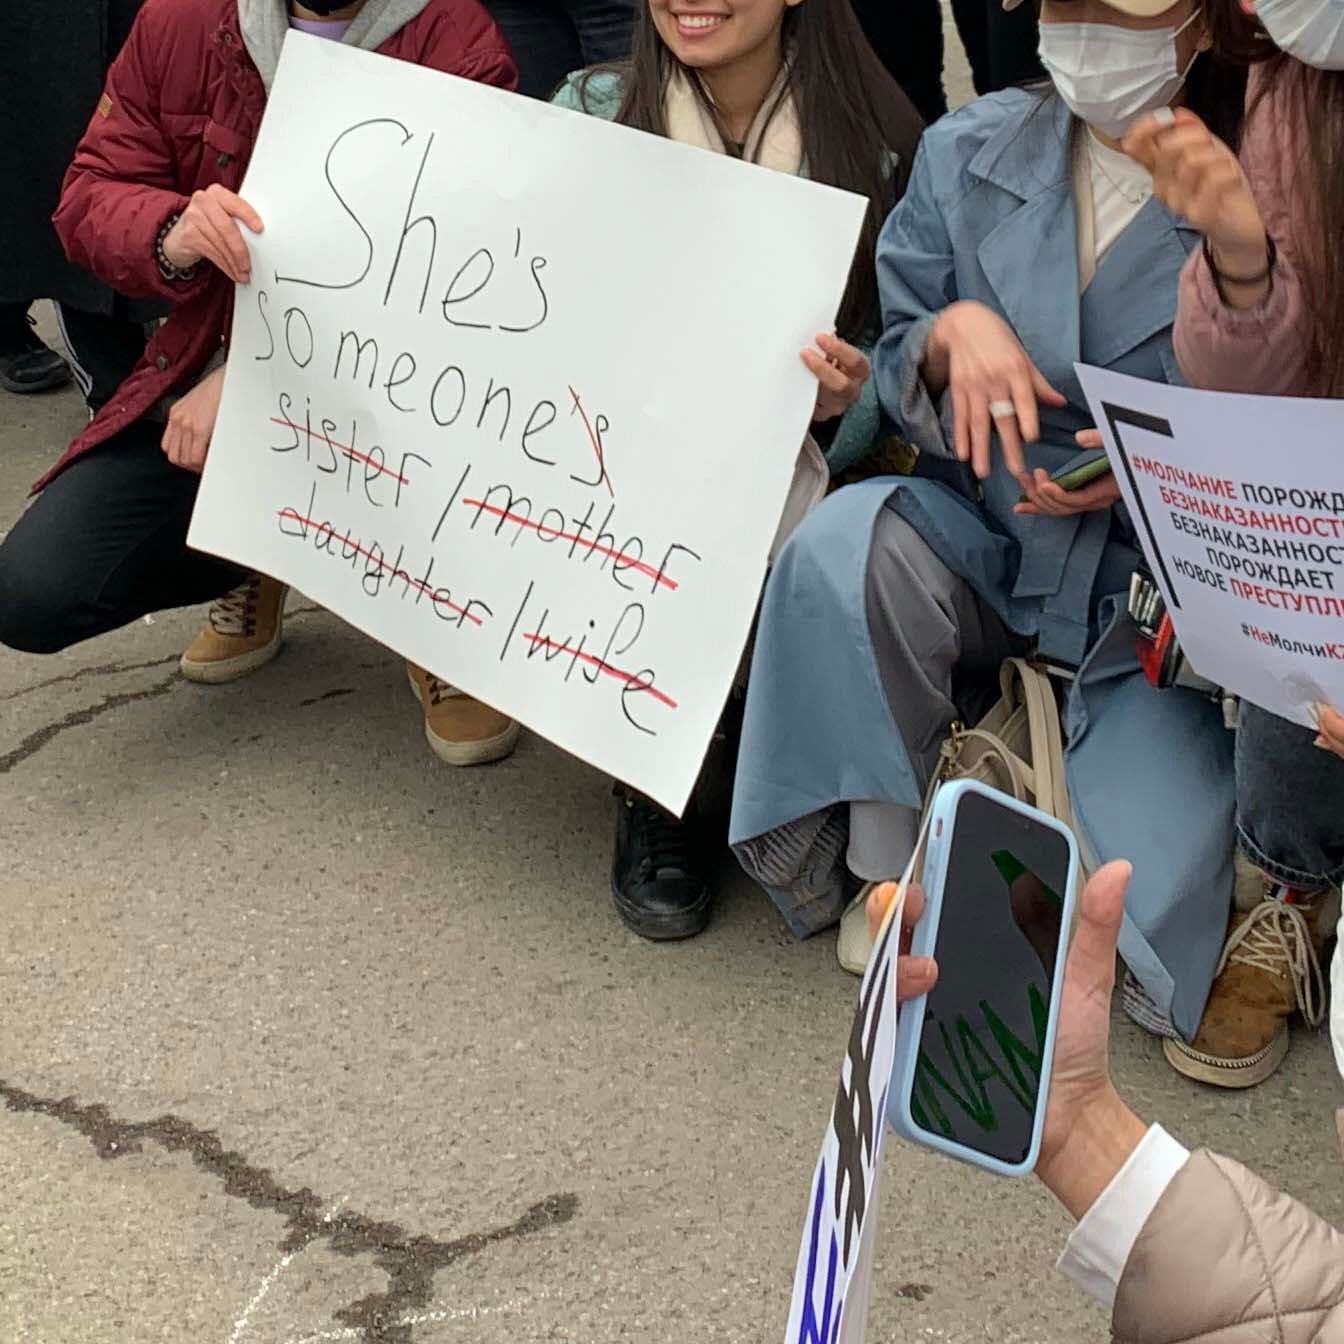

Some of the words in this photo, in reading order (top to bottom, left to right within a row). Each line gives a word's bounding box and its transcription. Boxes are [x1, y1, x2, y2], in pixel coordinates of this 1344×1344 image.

[276, 119, 548, 332] She's
[1133, 455, 1237, 501] #МОЛЧАНИЕ
[1172, 556, 1228, 594] НОВОЕ
[1206, 547, 1335, 591] ПОРОЖДАЕТ
